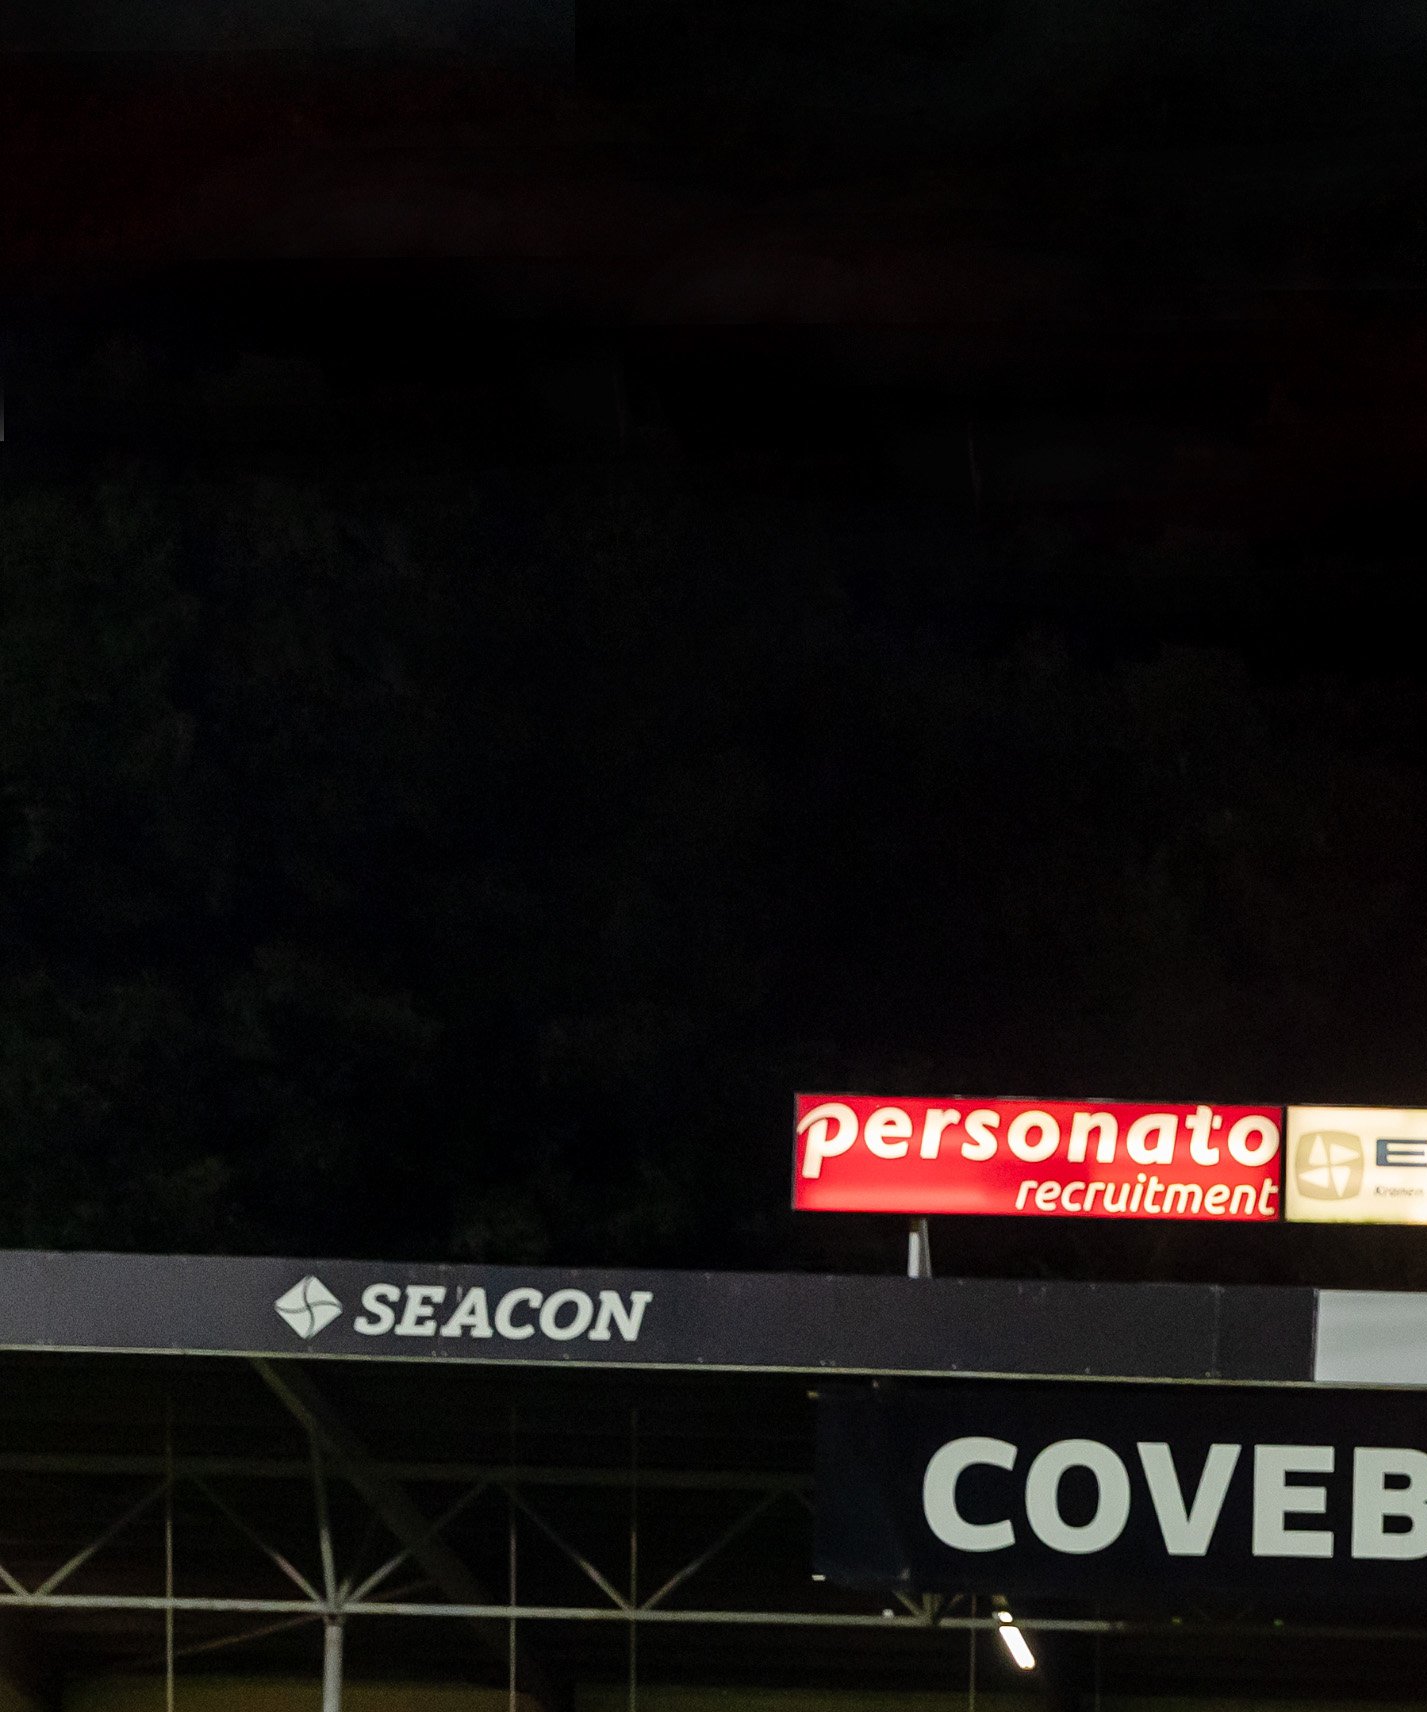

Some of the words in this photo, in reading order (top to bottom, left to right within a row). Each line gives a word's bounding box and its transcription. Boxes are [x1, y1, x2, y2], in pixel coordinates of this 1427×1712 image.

[796, 1103, 1281, 1179] personato
[1013, 1172, 1279, 1216] recruitment
[353, 1283, 654, 1342] SEACON
